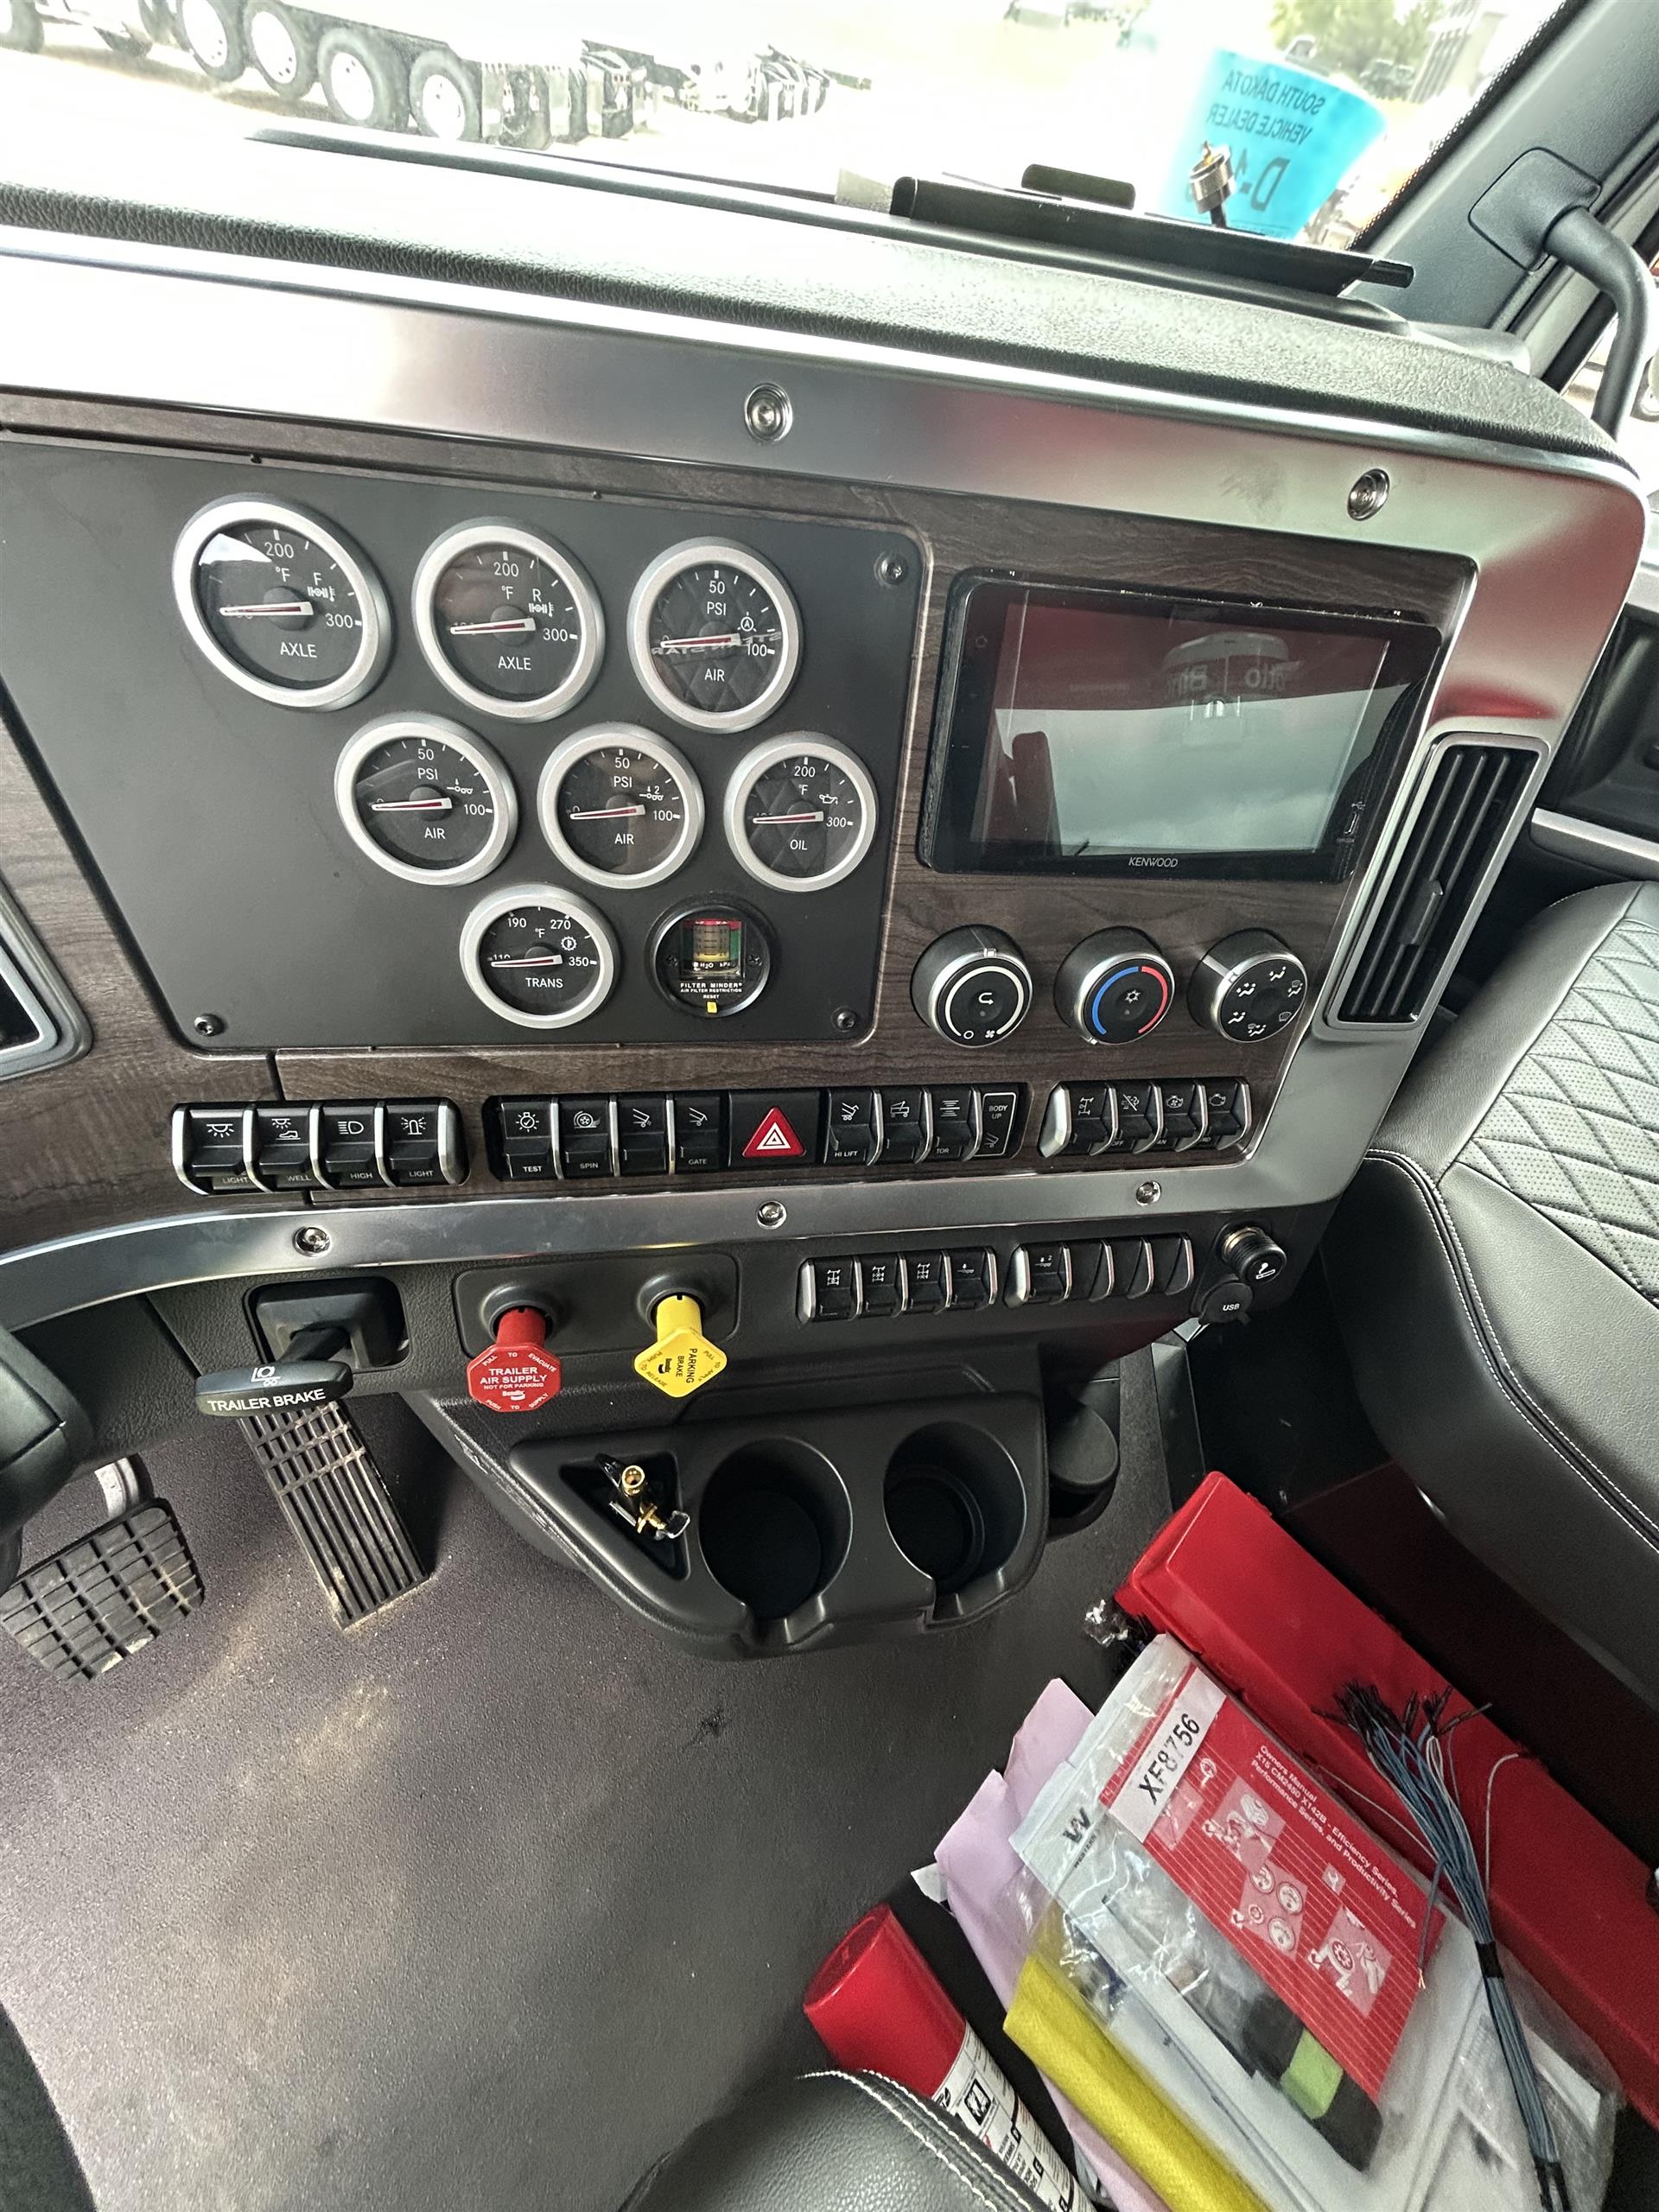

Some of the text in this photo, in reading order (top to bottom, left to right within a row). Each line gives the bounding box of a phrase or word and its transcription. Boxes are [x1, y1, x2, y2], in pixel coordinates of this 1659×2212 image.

[264, 542, 295, 558] 200
[493, 563, 519, 577] 200
[313, 572, 321, 585] F
[709, 581, 726, 594] 50
[532, 588, 542, 602] R
[707, 601, 727, 616] PSI
[326, 613, 353, 628] 300
[543, 628, 569, 642] 300
[280, 642, 318, 658] AXLE
[747, 644, 767, 657] 100
[498, 656, 532, 671] AXLE
[704, 669, 725, 682] AIR
[417, 748, 435, 761] 50
[614, 757, 630, 769] 50
[417, 767, 438, 780] PSI
[794, 766, 816, 778] 200
[613, 776, 632, 788] PSI
[654, 785, 660, 794] 2
[463, 804, 486, 816] 100
[652, 810, 673, 821] 100
[826, 817, 847, 828] 300
[424, 827, 446, 840] AIR
[614, 833, 634, 845] AIR
[790, 839, 808, 851] OIL
[1128, 856, 1179, 868] KENWOOD
[507, 918, 527, 928] 190
[550, 919, 571, 931] 270
[569, 957, 589, 967] 350
[525, 977, 563, 988] TRANS
[1223, 1303, 1240, 1312] USB
[482, 1355, 498, 1366] PULL
[528, 1353, 556, 1372] EVACUATE
[675, 1356, 684, 1377] BRAKE
[686, 1348, 698, 1383] PARKING
[488, 1367, 537, 1376] TRAILER
[207, 1388, 326, 1412] TRAILER BRAKE
[486, 1399, 501, 1410] PUSH
[529, 1393, 548, 1408] SUPPLY
[1139, 1713, 1199, 1805] XF8756
[1261, 1745, 1317, 1802] Owners Manual
[1255, 1751, 1270, 1769] X15
[1271, 1768, 1300, 1797] CM2450
[1301, 1797, 1326, 1823] X142B
[1332, 1827, 1370, 1867] Efficiency
[1251, 1760, 1298, 1808] Performance
[1326, 1834, 1342, 1851] and
[1344, 1850, 1389, 1901] Productivity
[1391, 1898, 1416, 1929] Series
